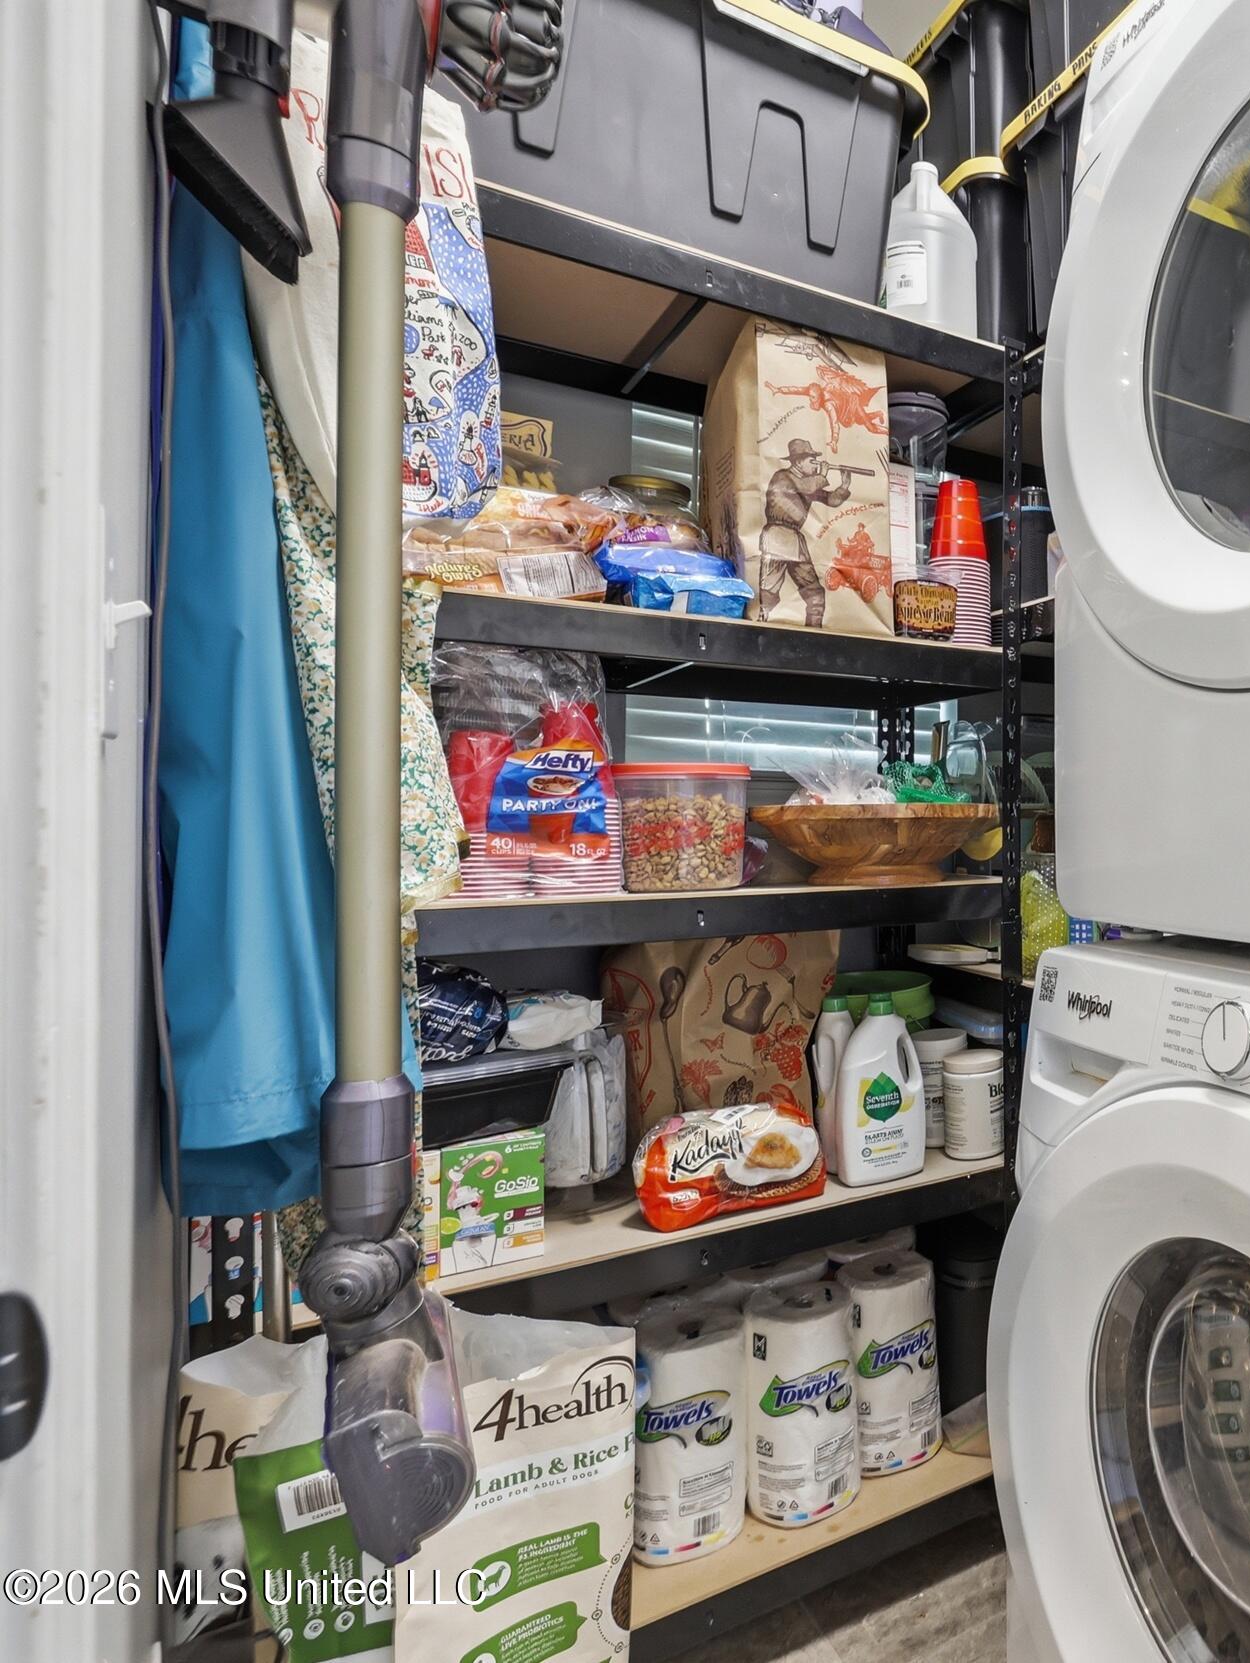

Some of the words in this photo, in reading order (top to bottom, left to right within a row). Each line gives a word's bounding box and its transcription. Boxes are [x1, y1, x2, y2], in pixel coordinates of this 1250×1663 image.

[1024, 80, 1062, 124] BAKING
[425, 561, 483, 579] Nature's
[441, 570, 475, 583] Own
[531, 752, 591, 770] Hefty
[502, 798, 562, 812] PARTY
[489, 837, 513, 850] 40
[569, 842, 587, 856] 18
[1067, 990, 1113, 1020] Whirlpool
[865, 1091, 900, 1104] Seventh
[869, 1328, 930, 1371] Towels
[773, 1370, 841, 1408] Towels
[472, 1373, 630, 1442] 4health
[642, 1399, 716, 1434] Towels
[473, 1462, 544, 1499] Lamb
[548, 1456, 569, 1475] &
[573, 1444, 620, 1470] Rice
[474, 1494, 504, 1510] FOOD
[508, 1486, 529, 1498] FOR
[533, 1477, 568, 1491] ADULT
[572, 1468, 600, 1482] DOGS
[573, 1528, 589, 1540] THE
